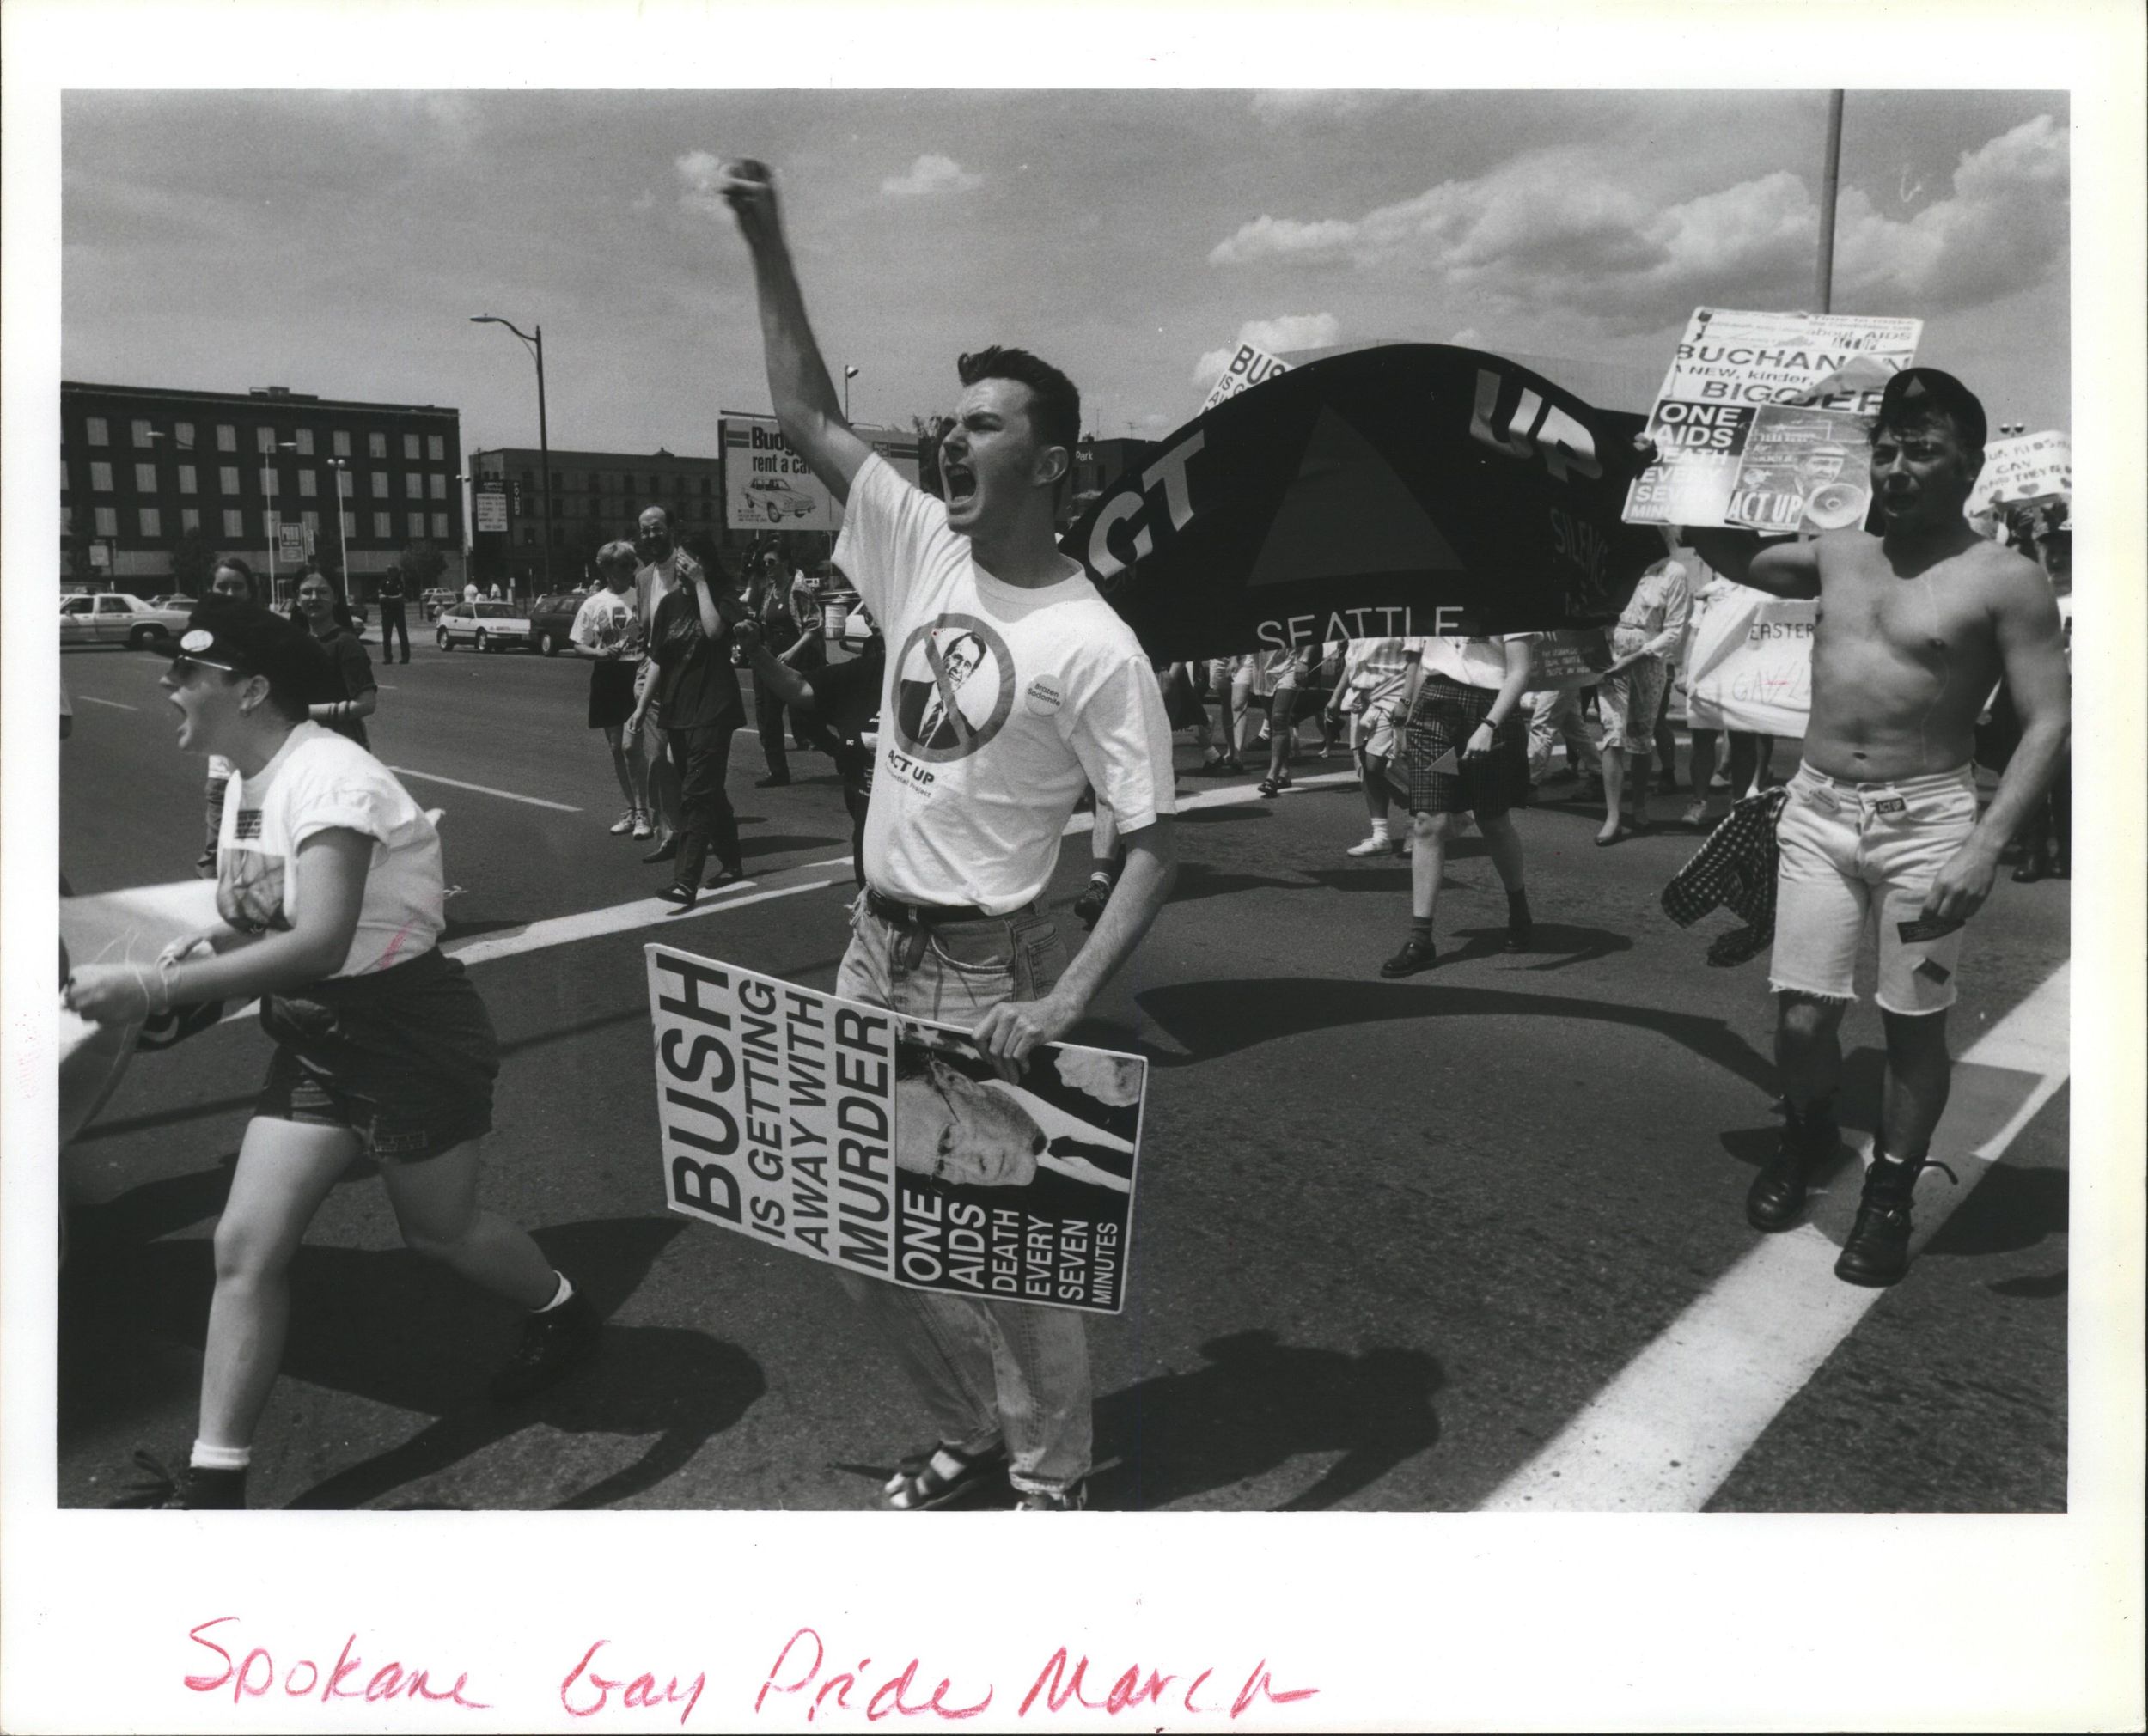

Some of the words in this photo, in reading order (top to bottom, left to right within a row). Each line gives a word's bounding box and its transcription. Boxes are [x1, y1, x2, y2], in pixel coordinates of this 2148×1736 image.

[1676, 343, 1910, 372] BUCHANN
[1863, 330, 1913, 342] AIDS
[1218, 374, 1234, 391] IS
[1687, 366, 1742, 379] NEW,
[1747, 369, 1815, 387] kinder,
[1651, 424, 1734, 448] AIDS
[1658, 403, 1742, 428] ONE
[752, 454, 778, 472] rent
[780, 457, 789, 473] a
[1075, 449, 1094, 461] Park
[1088, 430, 1205, 580] CT
[1727, 490, 1770, 521] ACT
[1773, 493, 1803, 524] UP
[1257, 606, 1464, 649] SEATTLE
[1027, 688, 1061, 707] Sodomite
[1034, 683, 1059, 697] Brazen
[888, 749, 913, 772] ACT
[912, 766, 935, 785] UP
[786, 990, 827, 1113] WITH
[656, 953, 743, 1226] BUSH
[738, 979, 784, 1183] GETTING
[834, 1008, 889, 1274] MURDER
[790, 1118, 830, 1256] AWAY
[750, 1195, 786, 1240] IS
[902, 1188, 943, 1282] ONE
[948, 1201, 986, 1289] AIDS
[992, 1209, 1020, 1293] DEATH
[1025, 1214, 1054, 1297] EVERY
[1058, 1218, 1088, 1301] SEVEN
[1091, 1221, 1118, 1305] MINUTES
[184, 1616, 494, 1709] Spokane
[560, 1640, 706, 1725] Gay
[755, 1627, 994, 1722] Pride
[1019, 1646, 1321, 1719] March
